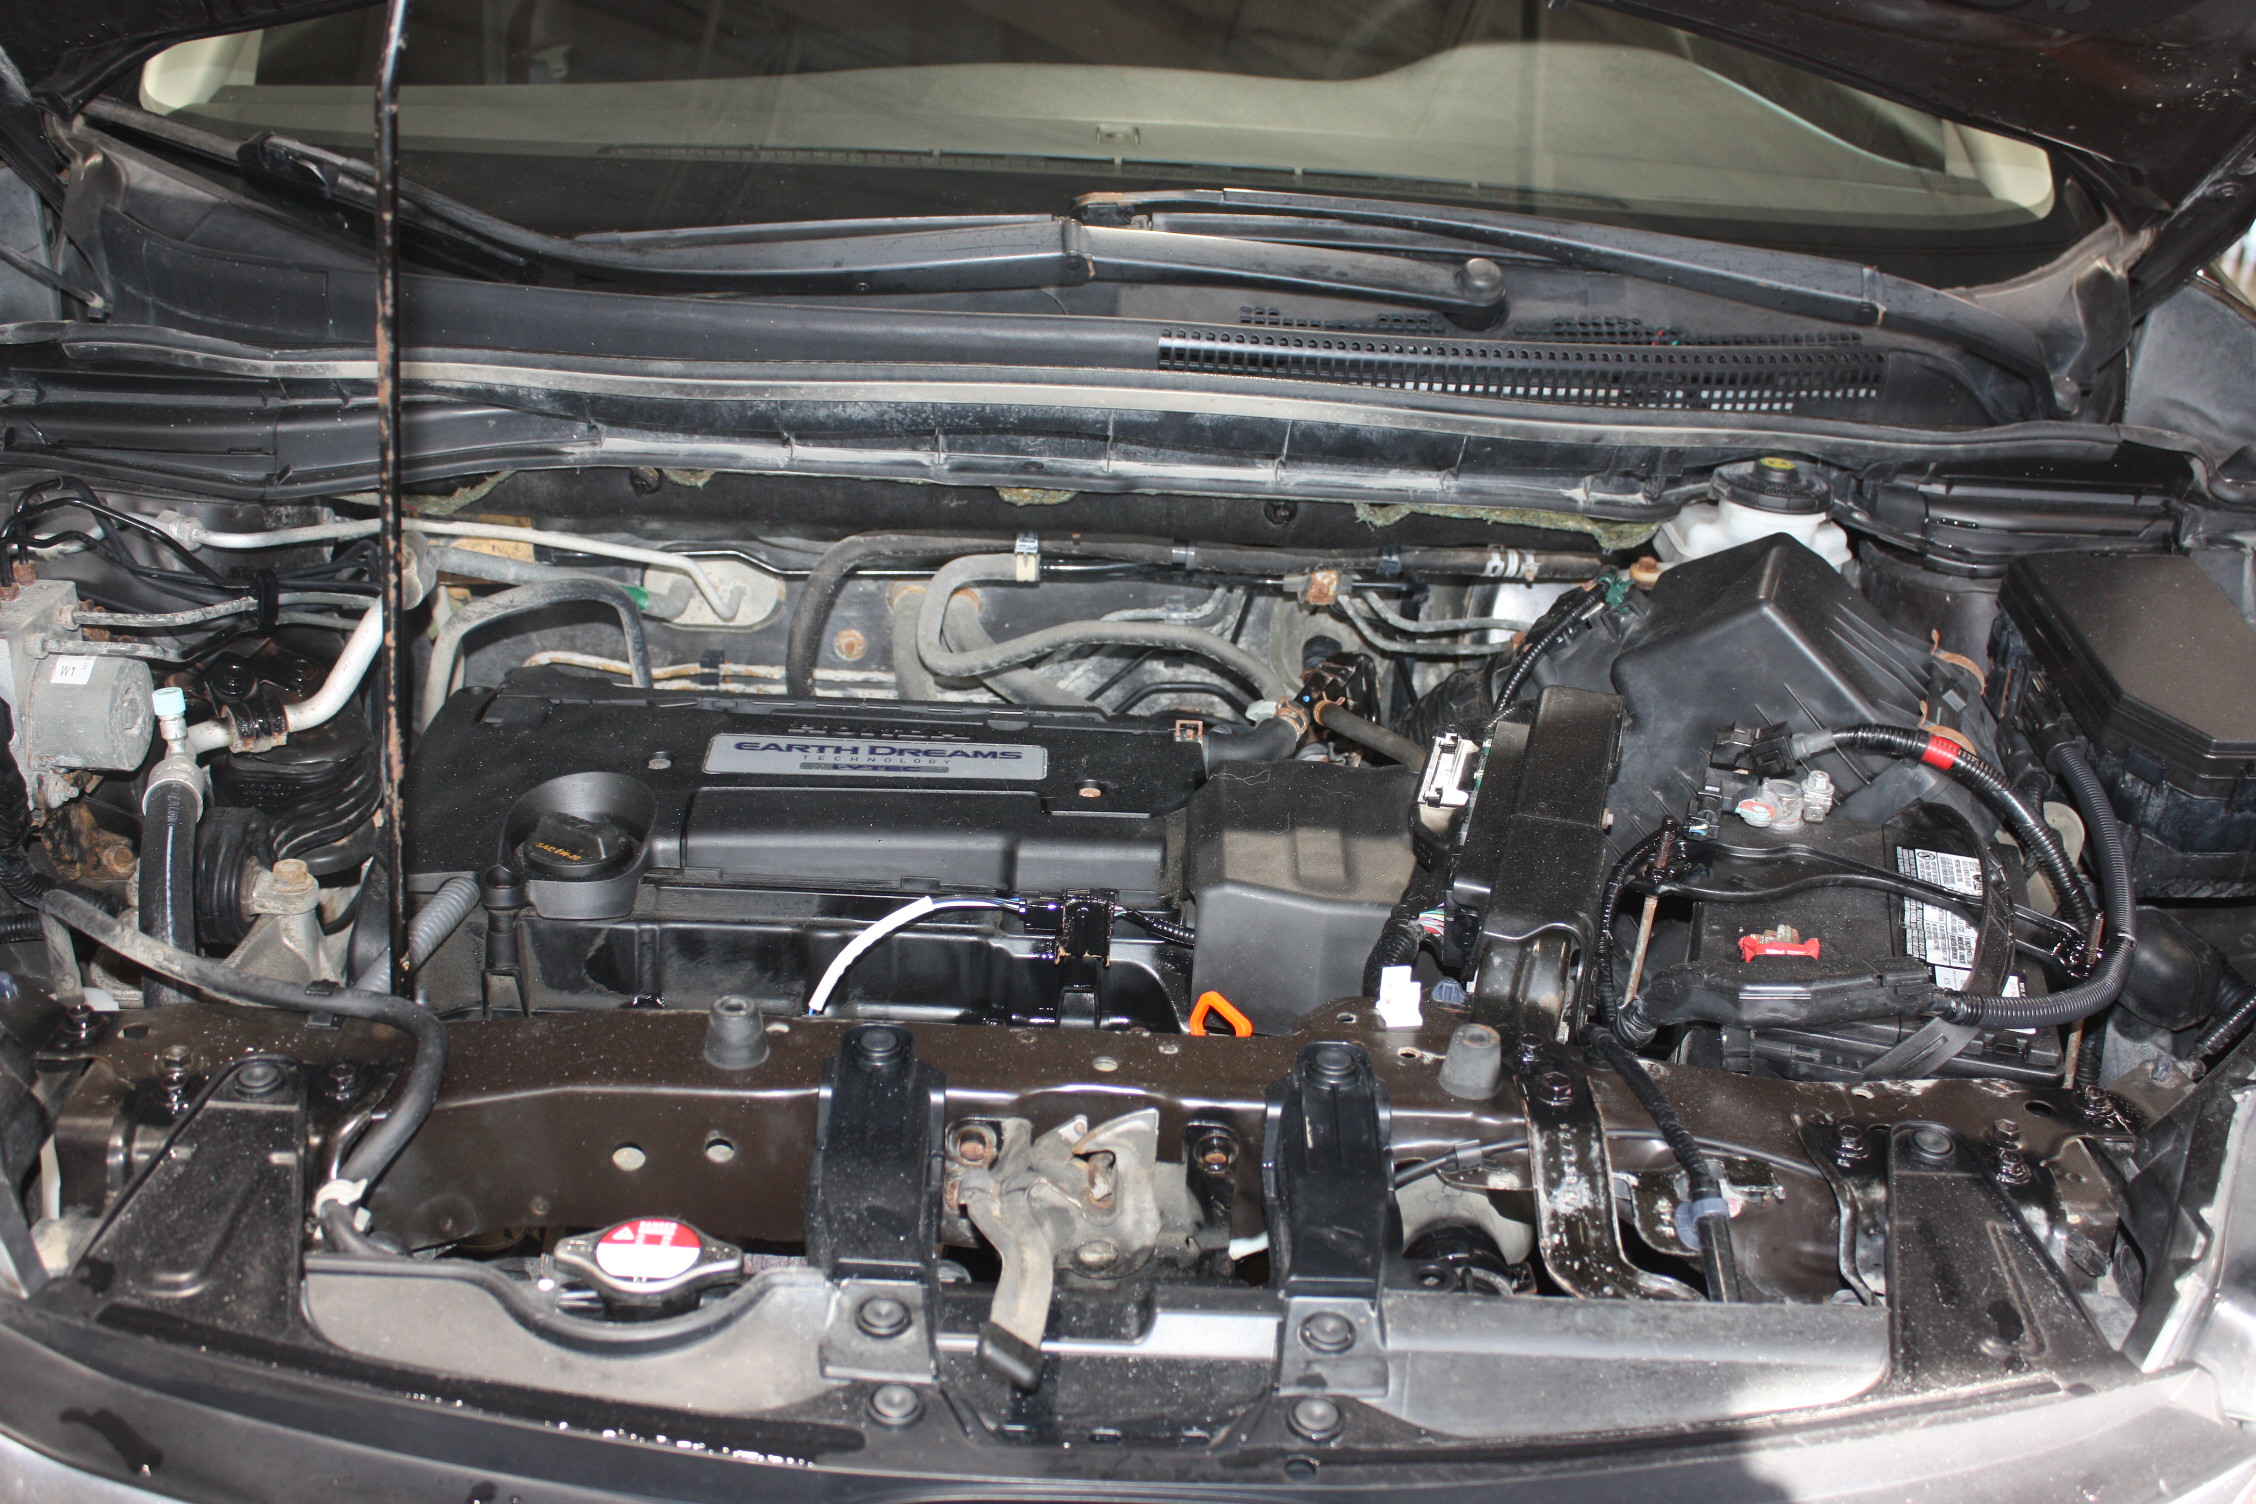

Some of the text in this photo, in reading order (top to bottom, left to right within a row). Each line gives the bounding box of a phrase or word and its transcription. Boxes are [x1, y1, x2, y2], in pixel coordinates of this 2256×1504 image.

[60, 665, 76, 677] W1
[734, 741, 1023, 760] EARTH DREAMS
[802, 754, 951, 765] TECHNOLOGY
[536, 843, 555, 851] SAE
